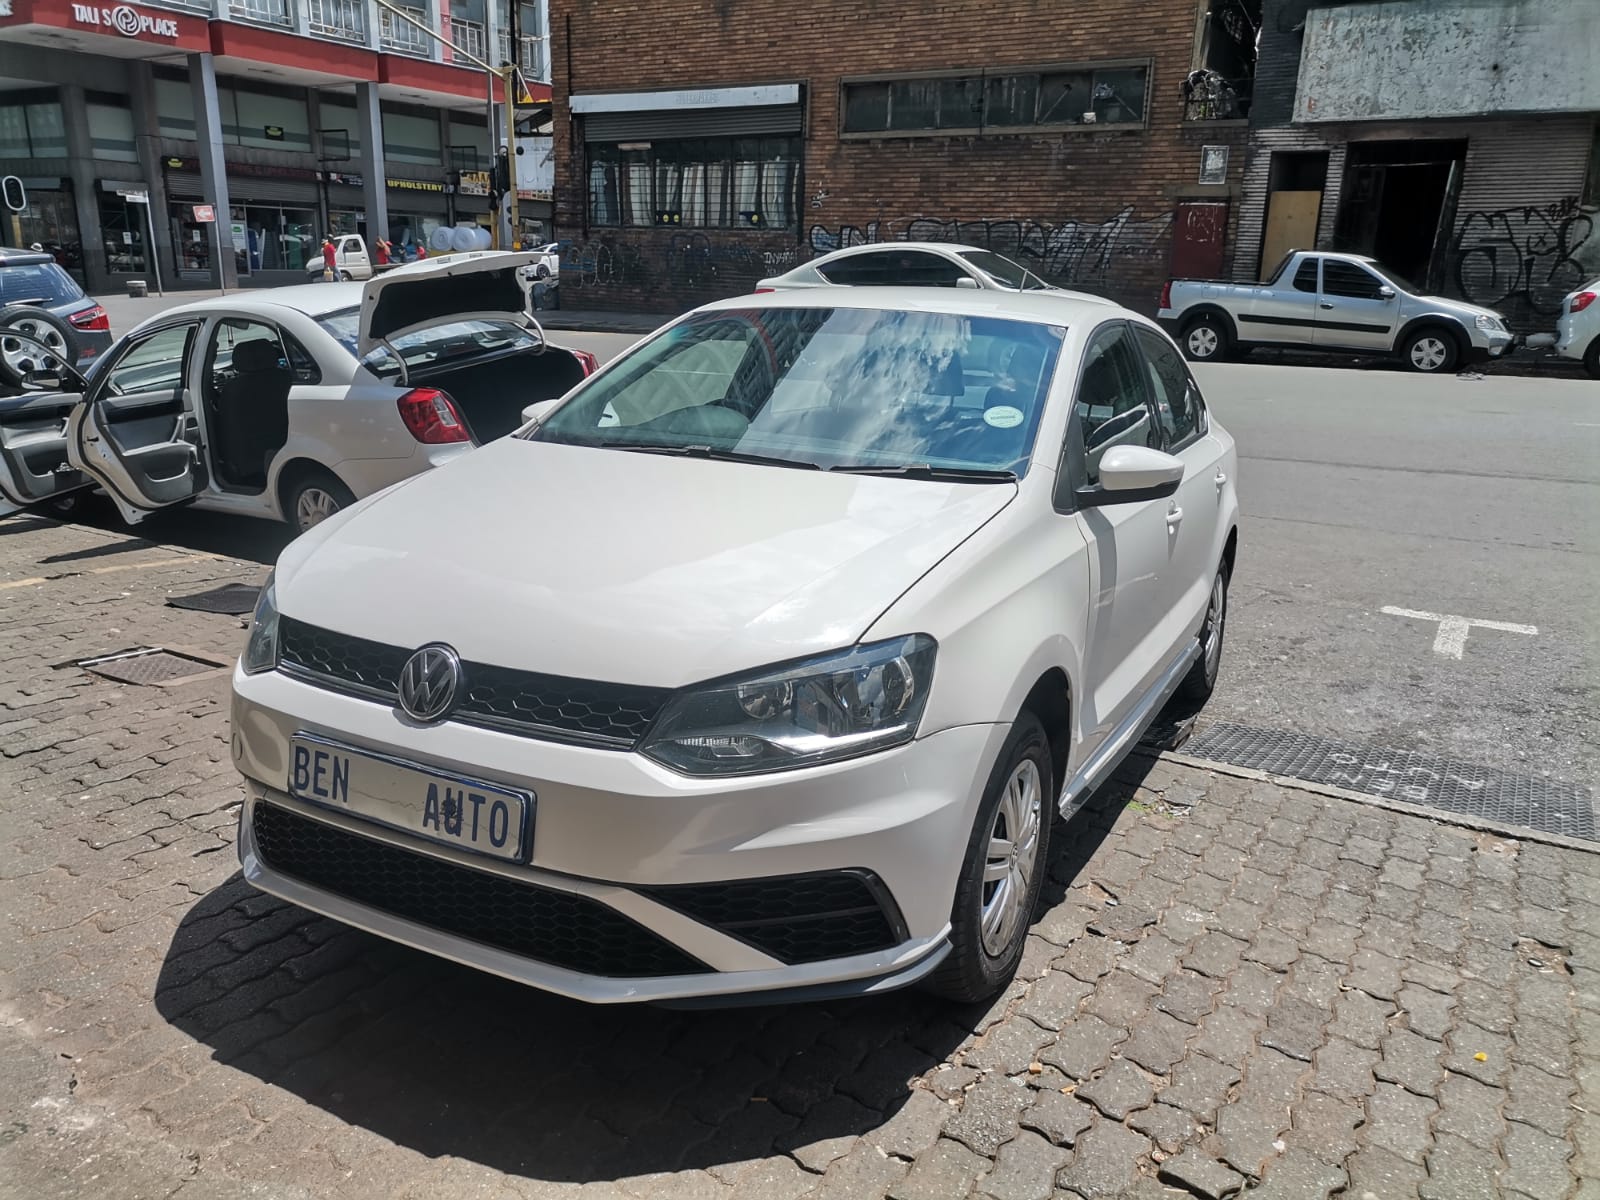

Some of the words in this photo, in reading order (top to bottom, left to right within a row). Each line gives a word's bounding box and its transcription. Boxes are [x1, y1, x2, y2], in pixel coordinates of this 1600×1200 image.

[141, 15, 178, 37] PLACE
[387, 179, 442, 191] UPHOLSTERY
[294, 746, 349, 803] BEN
[423, 783, 509, 848] AUTO
